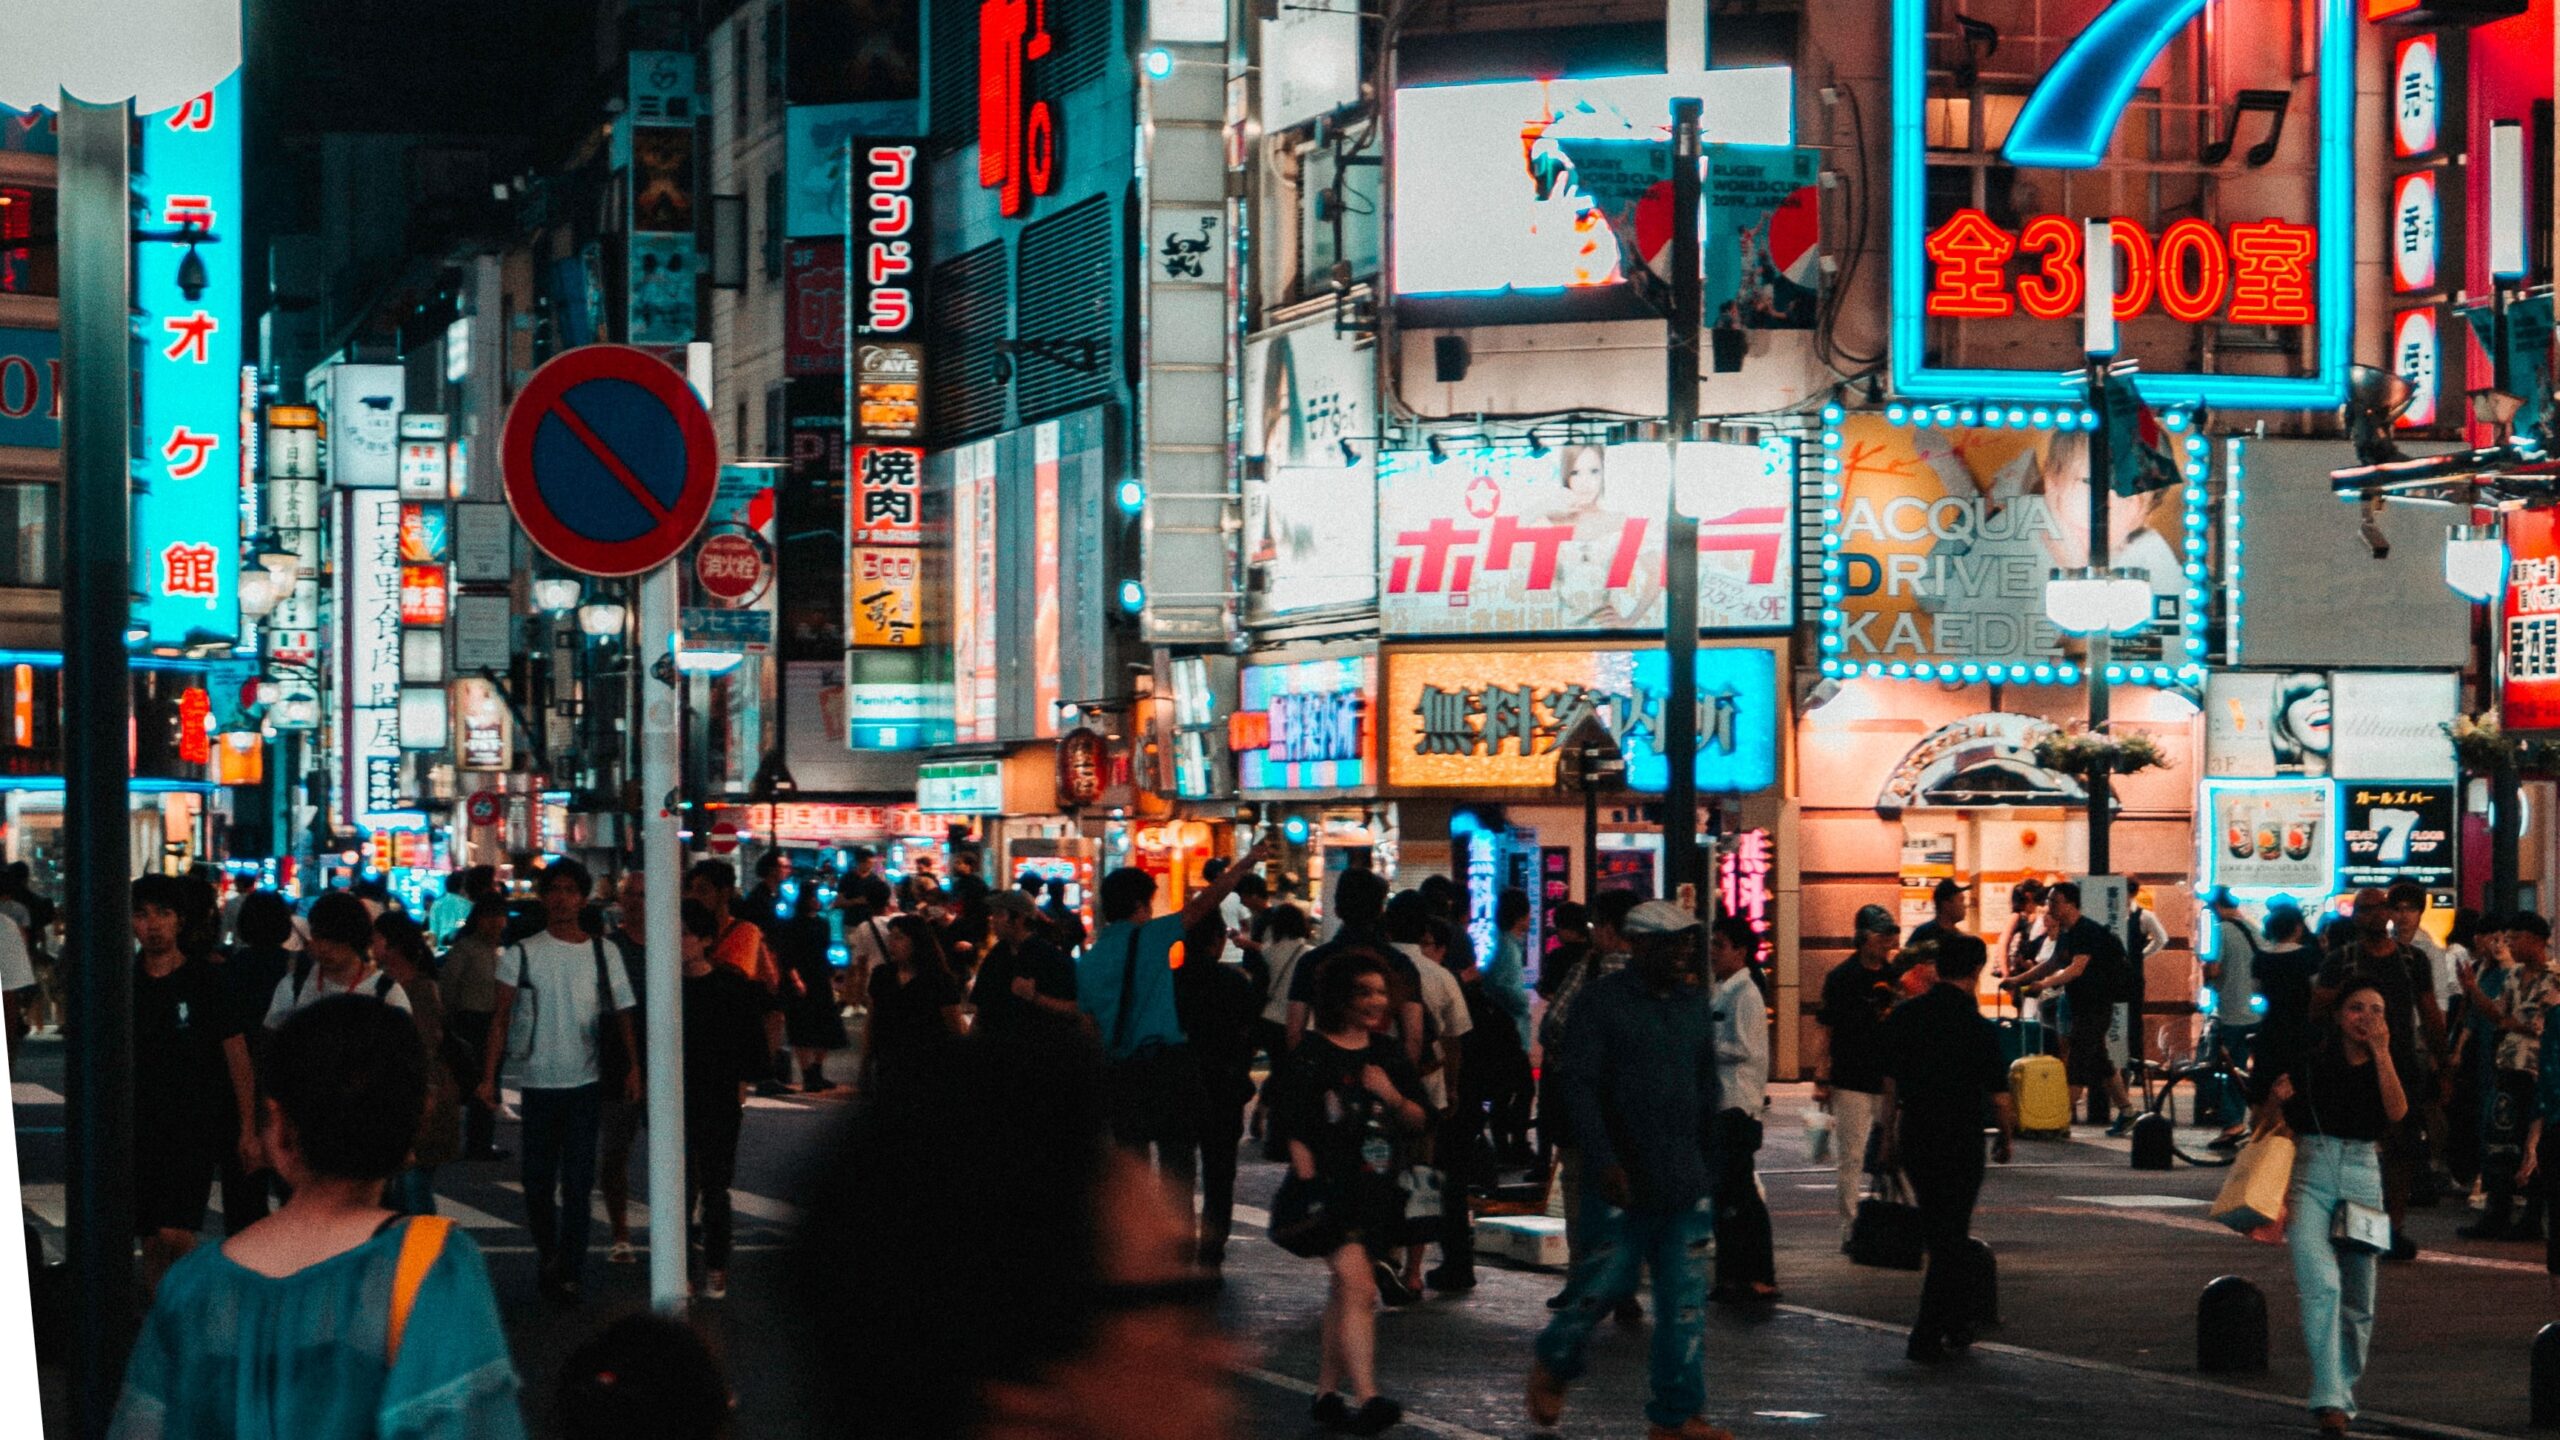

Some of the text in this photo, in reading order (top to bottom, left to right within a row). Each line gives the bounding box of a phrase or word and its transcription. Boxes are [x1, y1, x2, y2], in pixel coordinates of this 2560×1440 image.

[866, 146, 916, 332] ゴンドラ
[861, 448, 917, 524] 焼肉
[1841, 497, 2064, 542] ACQUA
[704, 553, 755, 579] 消火栓
[1839, 552, 2038, 599] DRIVE
[1839, 611, 2064, 656] KAEDE
[2369, 808, 2420, 861] 7
